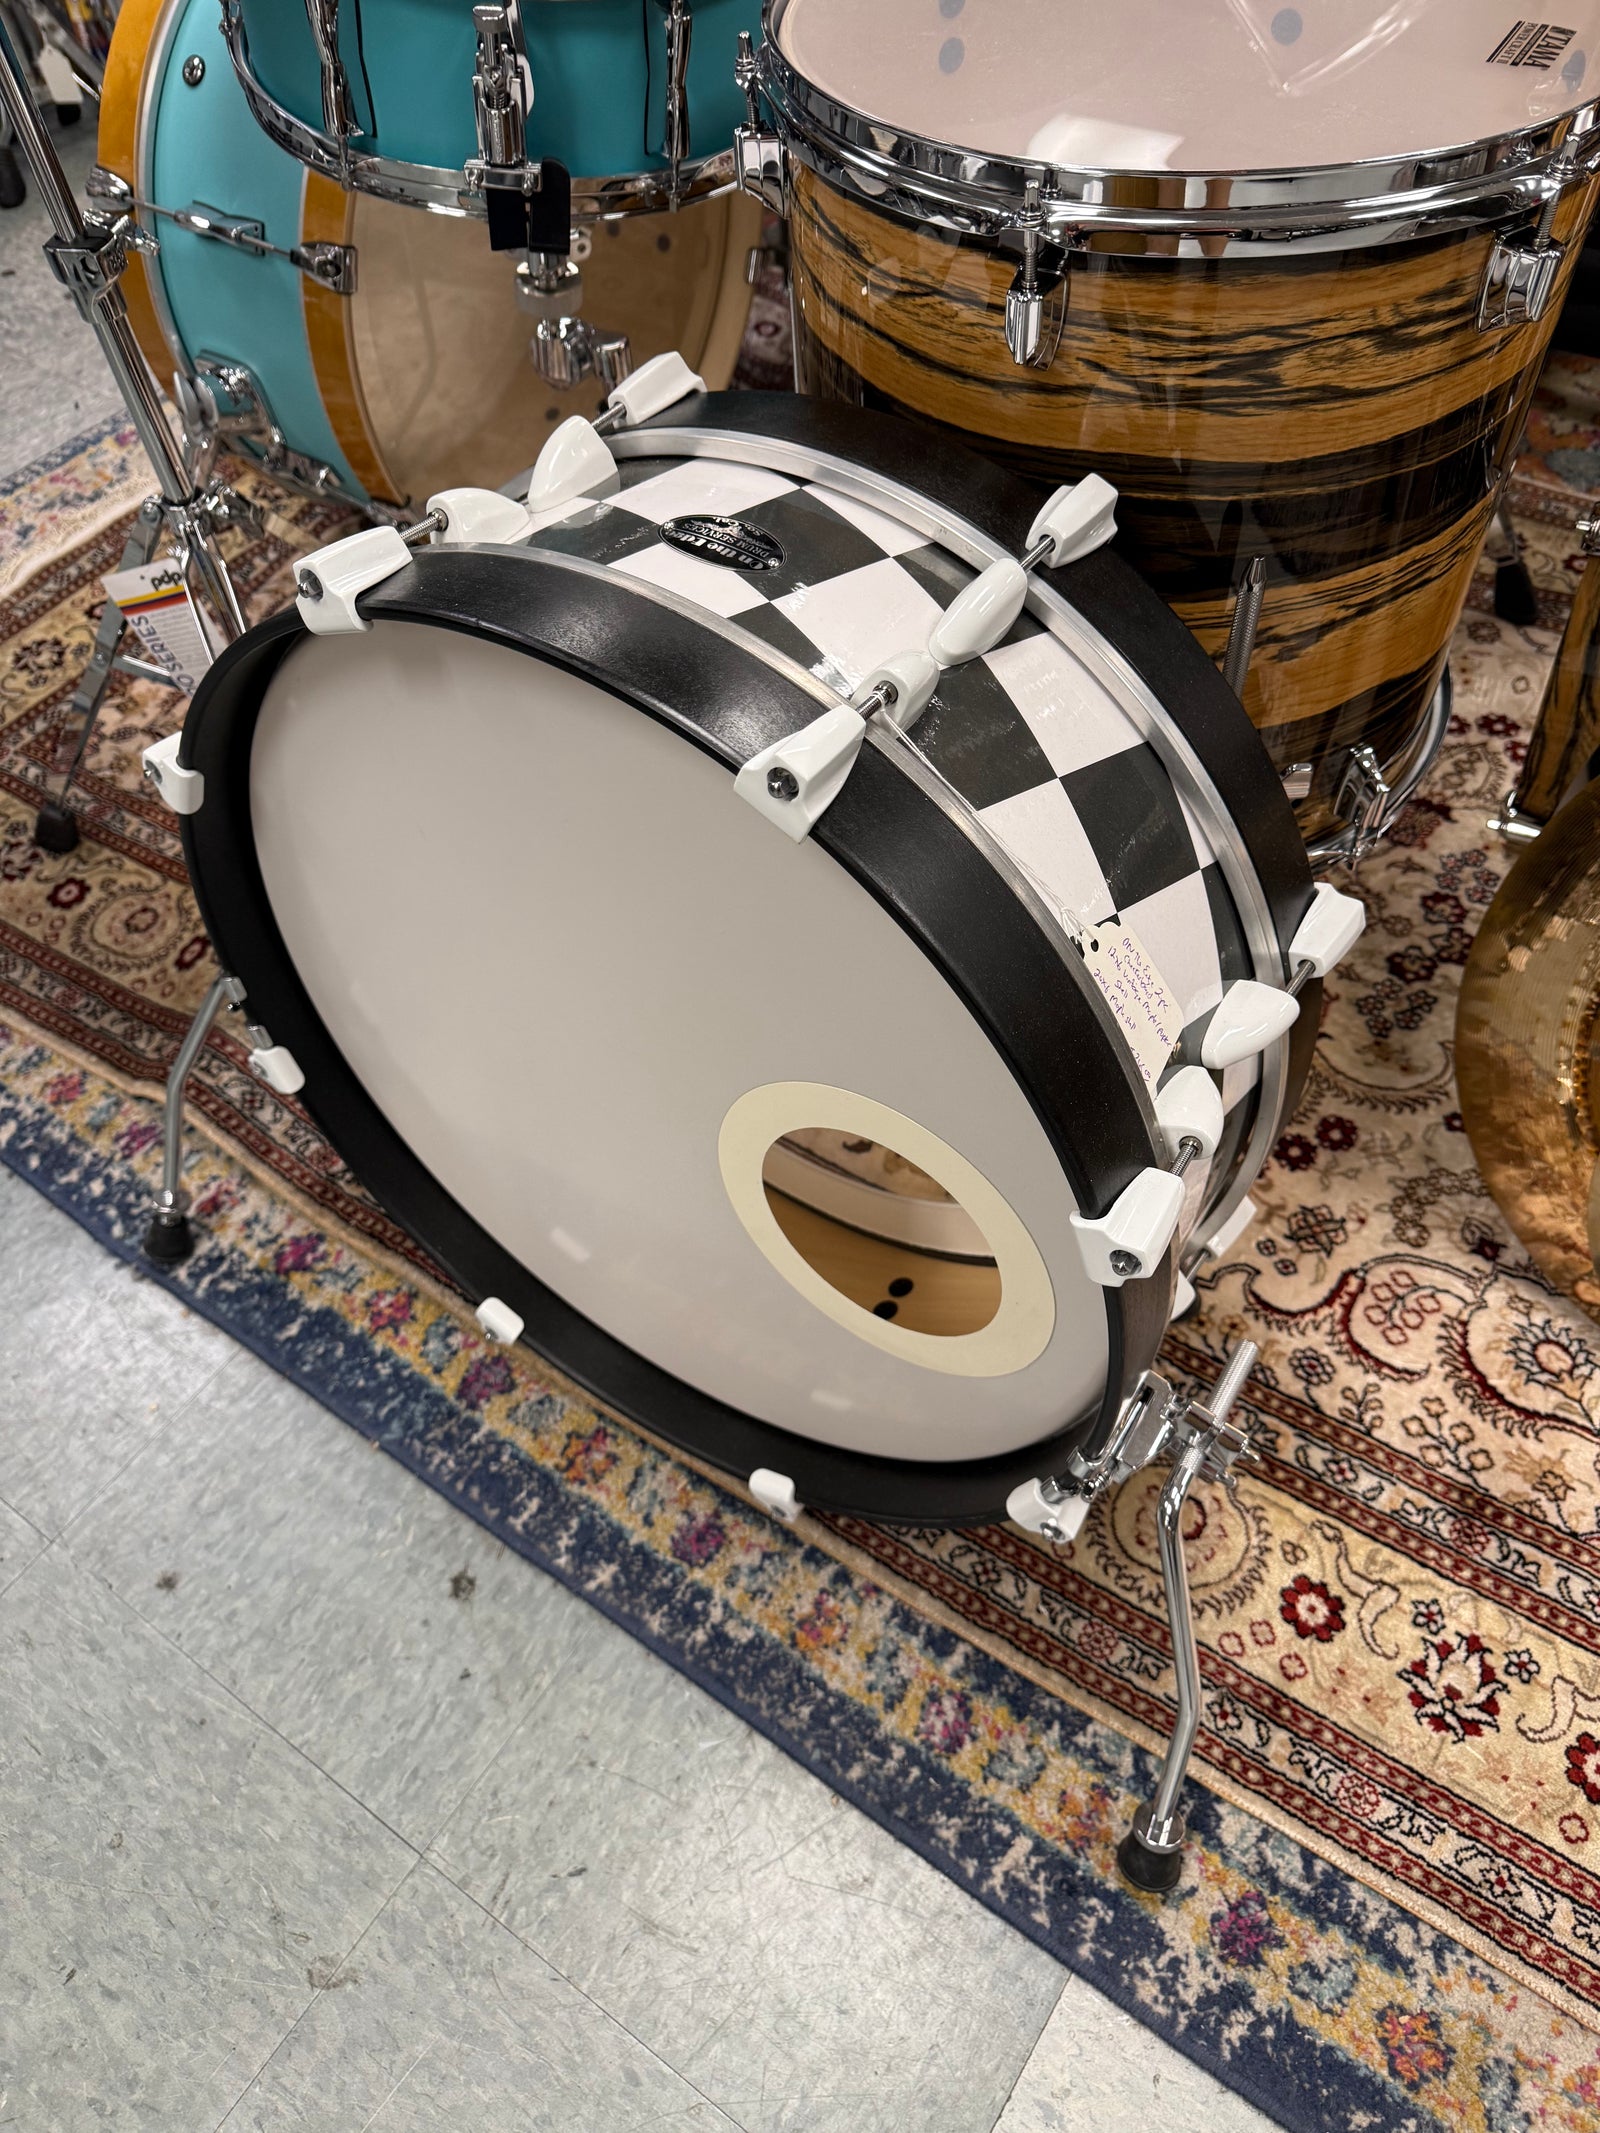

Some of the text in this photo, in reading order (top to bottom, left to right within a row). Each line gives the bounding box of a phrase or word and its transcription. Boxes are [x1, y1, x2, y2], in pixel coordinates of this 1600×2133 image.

[1522, 33, 1571, 69] TAMA
[681, 522, 770, 558] DRUM SERVICES
[706, 541, 737, 559] the
[737, 554, 764, 570] On
[151, 568, 182, 592] pdp
[131, 614, 184, 672] SERIES
